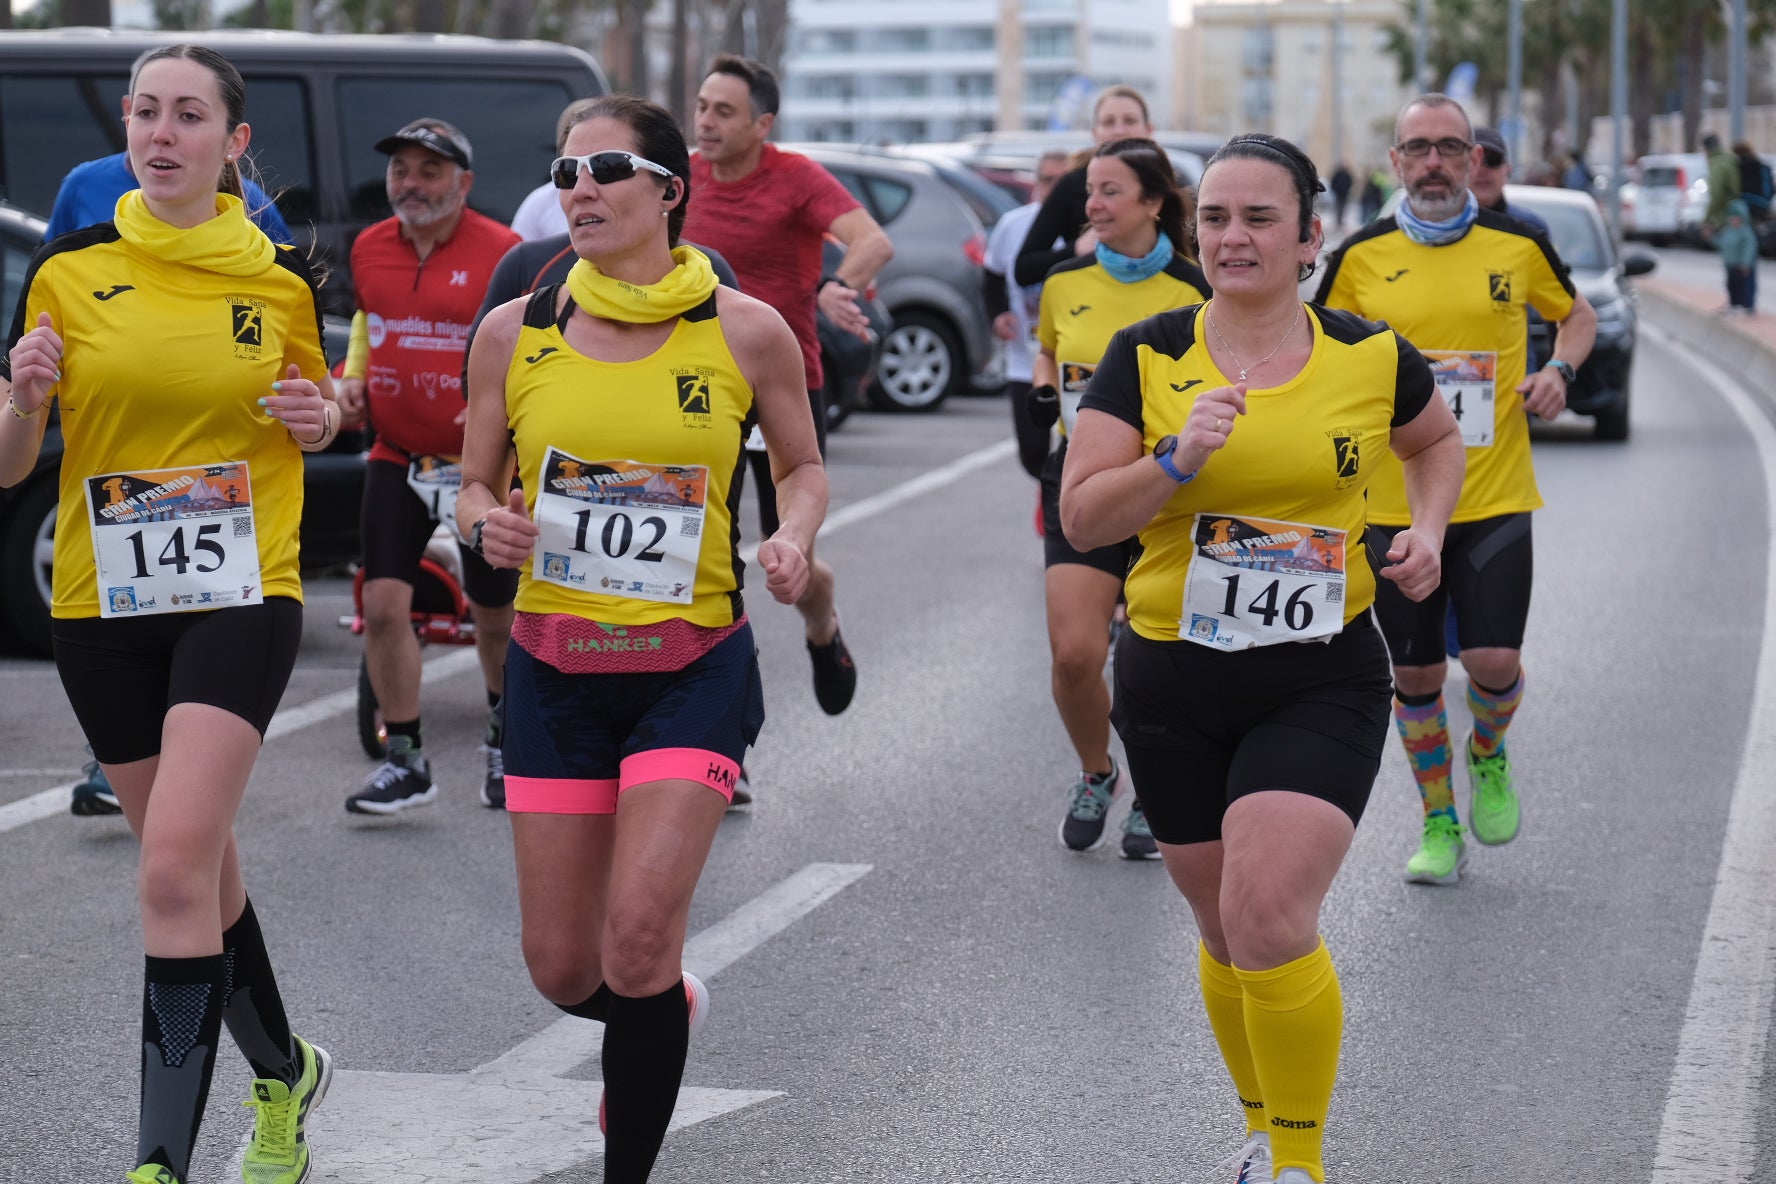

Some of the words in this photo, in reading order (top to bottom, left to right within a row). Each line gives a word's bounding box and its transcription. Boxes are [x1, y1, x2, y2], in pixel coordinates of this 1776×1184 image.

[225, 296, 244, 305] Vida
[248, 298, 267, 309] Sana
[385, 315, 433, 336] muebles
[233, 344, 239, 353] y
[244, 344, 262, 355] Feliz
[669, 367, 690, 376] Vida
[694, 367, 715, 377] Sana
[681, 413, 688, 423] y
[693, 413, 713, 422] Feliz
[550, 475, 592, 490] GRAN
[594, 468, 652, 485] PREMIO
[99, 496, 141, 519] GRAN
[135, 474, 196, 506] PREMIO
[565, 488, 593, 498] CIUDAD
[114, 510, 142, 524] CIUDAD
[141, 507, 153, 517] DE
[568, 508, 667, 563] 102
[1200, 541, 1244, 556] GRAN
[1241, 529, 1302, 549] PREMIO
[124, 523, 226, 579] 145
[1242, 555, 1253, 563] DE
[1216, 573, 1319, 631] 146
[566, 637, 664, 653] HANKER
[1270, 1116, 1318, 1130] Joma
